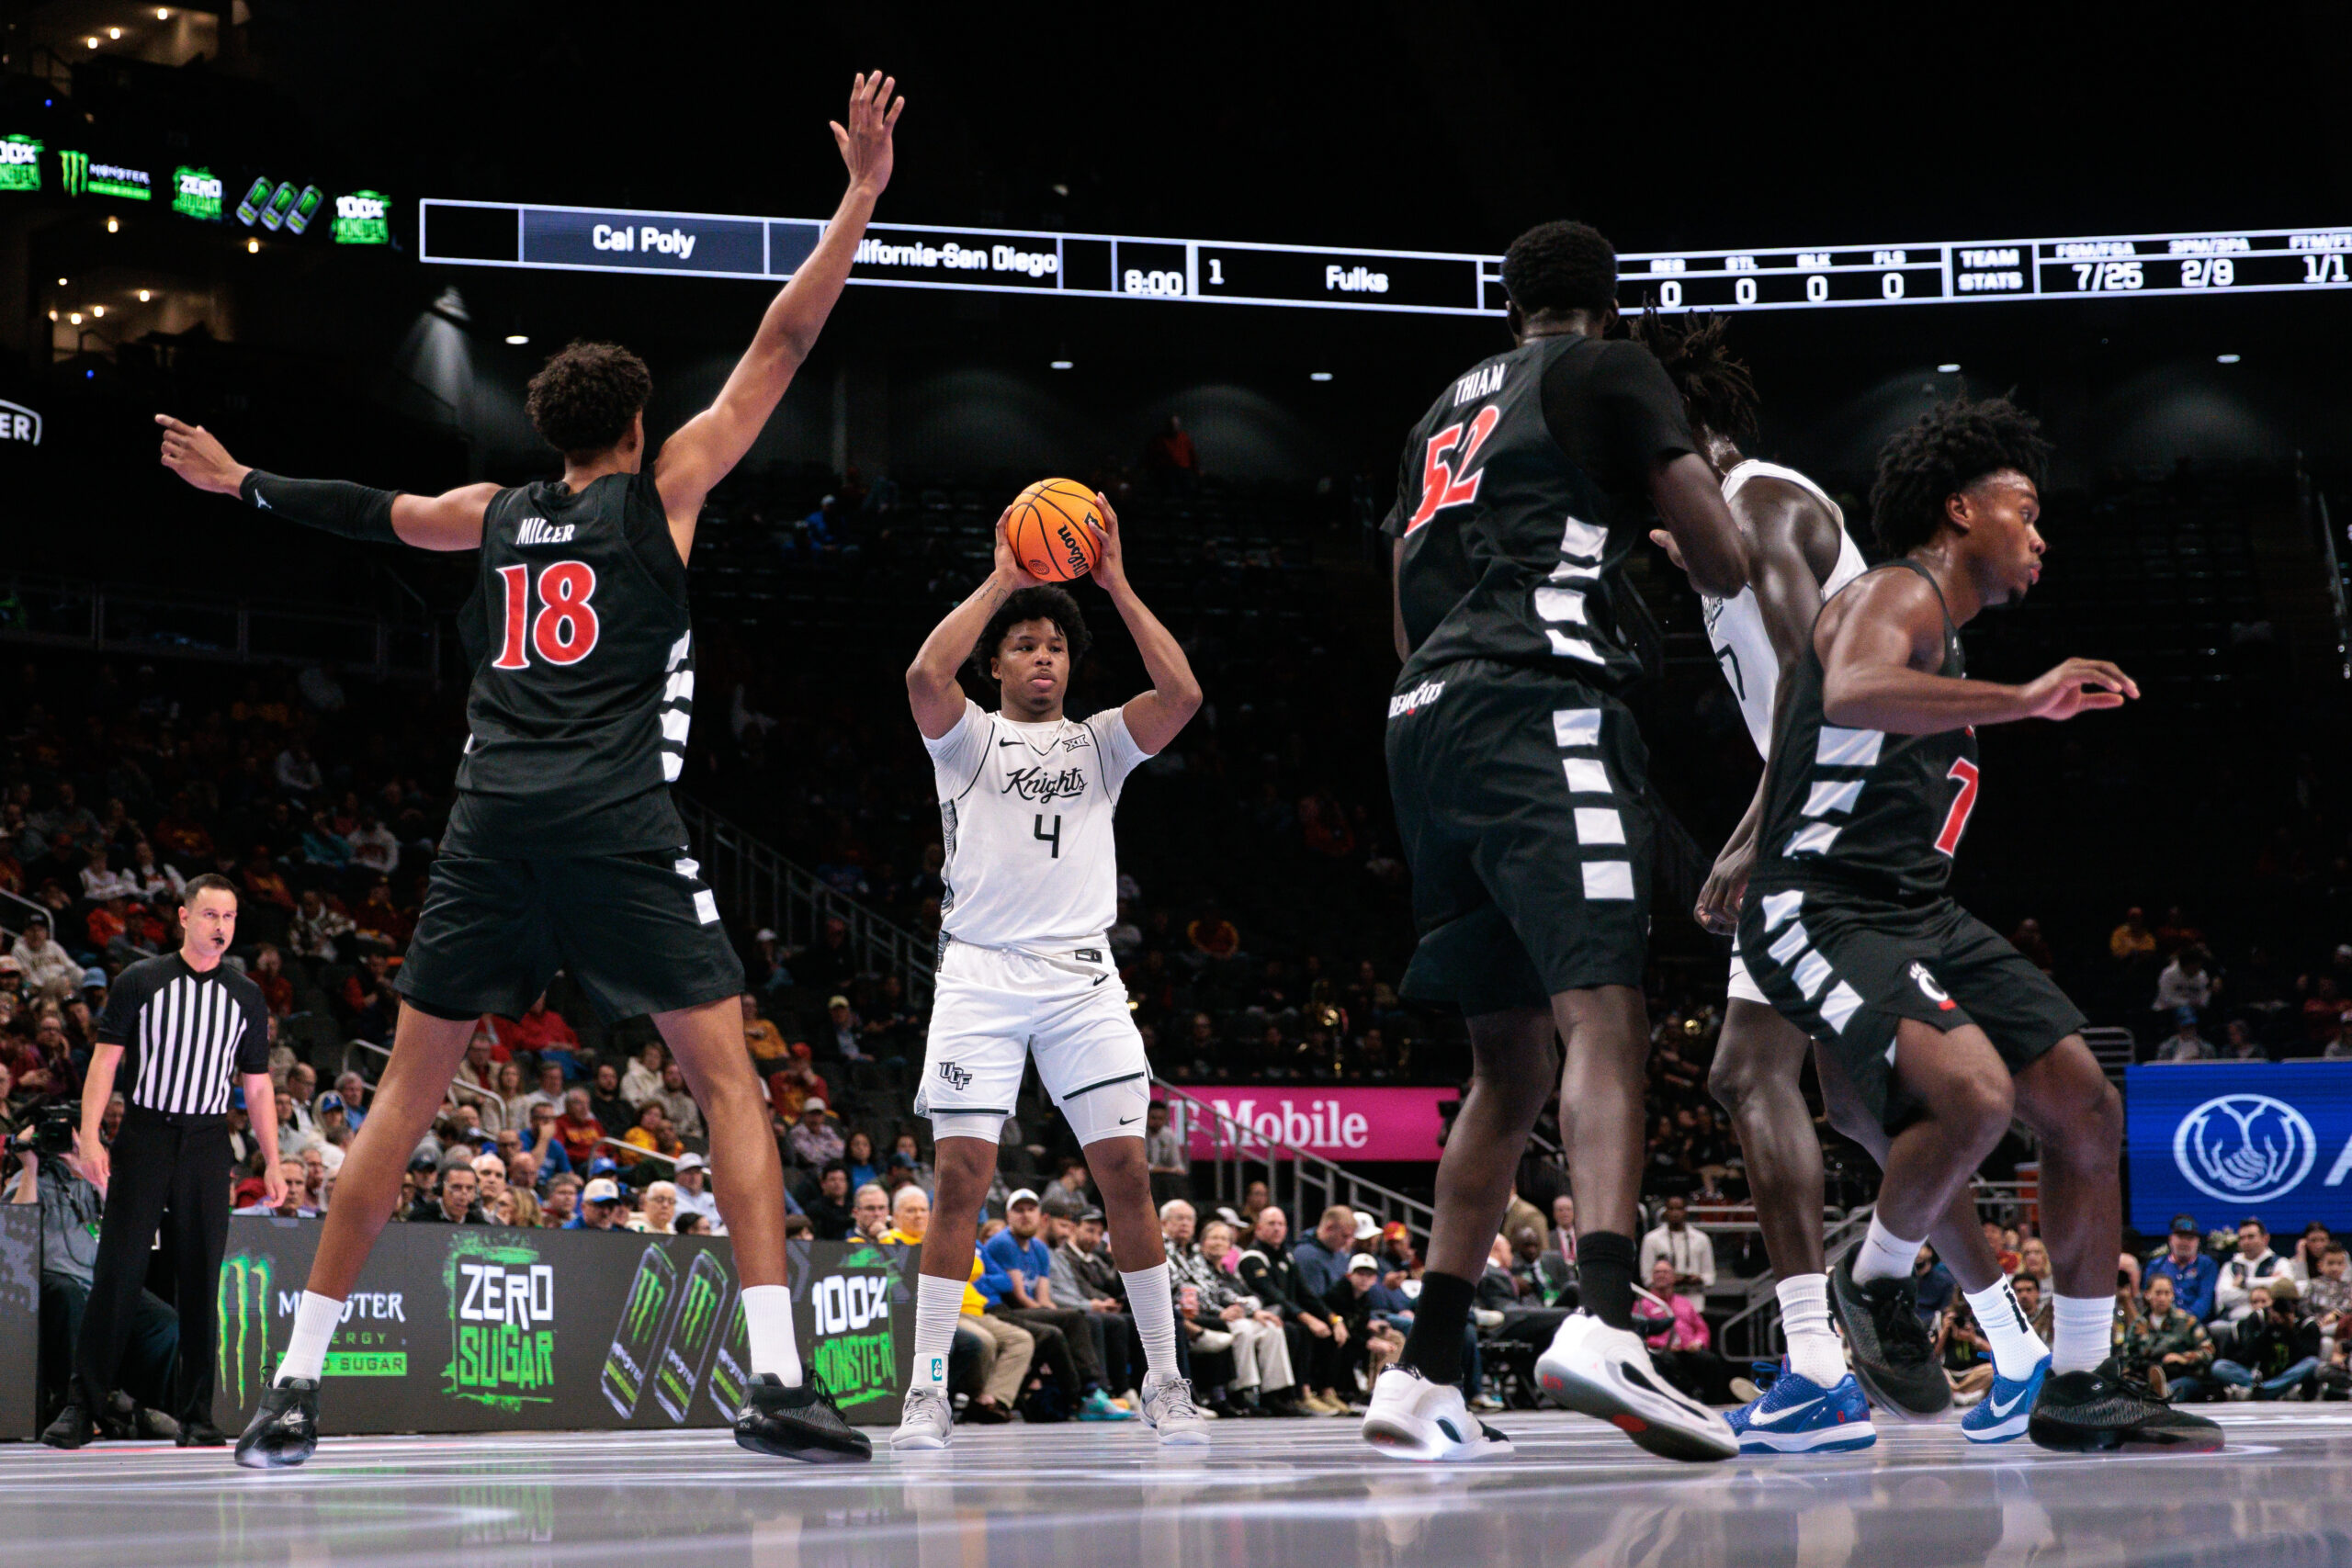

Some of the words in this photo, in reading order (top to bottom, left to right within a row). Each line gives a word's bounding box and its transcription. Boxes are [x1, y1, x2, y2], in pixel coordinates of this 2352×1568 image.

[89, 164, 151, 185] MONSTER
[180, 175, 222, 198] ZERO
[336, 196, 384, 219] 100%
[593, 224, 634, 252] Cal
[640, 227, 695, 259] Poly
[2289, 233, 2352, 250] FTM/FT
[854, 238, 988, 270] lifornia-San
[992, 245, 1058, 277] Diego
[1960, 249, 2020, 268] TEAM
[2302, 254, 2349, 283] 1/1
[1124, 269, 1184, 296] 8:00
[1208, 259, 1225, 285] 1
[1326, 265, 1389, 292] Fulks
[1806, 275, 1828, 302] 0
[1883, 272, 1905, 299] 0
[1958, 271, 2024, 291] STATS
[2072, 261, 2144, 291] 7/25
[1660, 280, 1682, 307] 0
[1736, 277, 1758, 304] 0
[1453, 363, 1506, 407] THIAM
[1404, 404, 1500, 538] 52
[516, 517, 575, 545] MILLER
[1057, 524, 1091, 577] Wilson
[492, 560, 599, 669] 18
[1001, 766, 1089, 804] Knights
[1034, 814, 1061, 858] 4
[938, 1061, 973, 1090] UCF
[1212, 1100, 1368, 1148] Mobile
[278, 1291, 406, 1323] MSTER
[460, 1265, 553, 1330] ZERO
[812, 1275, 888, 1336] 100%
[331, 1332, 386, 1345] ERGY
[340, 1358, 402, 1371] SUGAR
[460, 1325, 554, 1390] SUGAR
[814, 1331, 895, 1395] MONSTER
